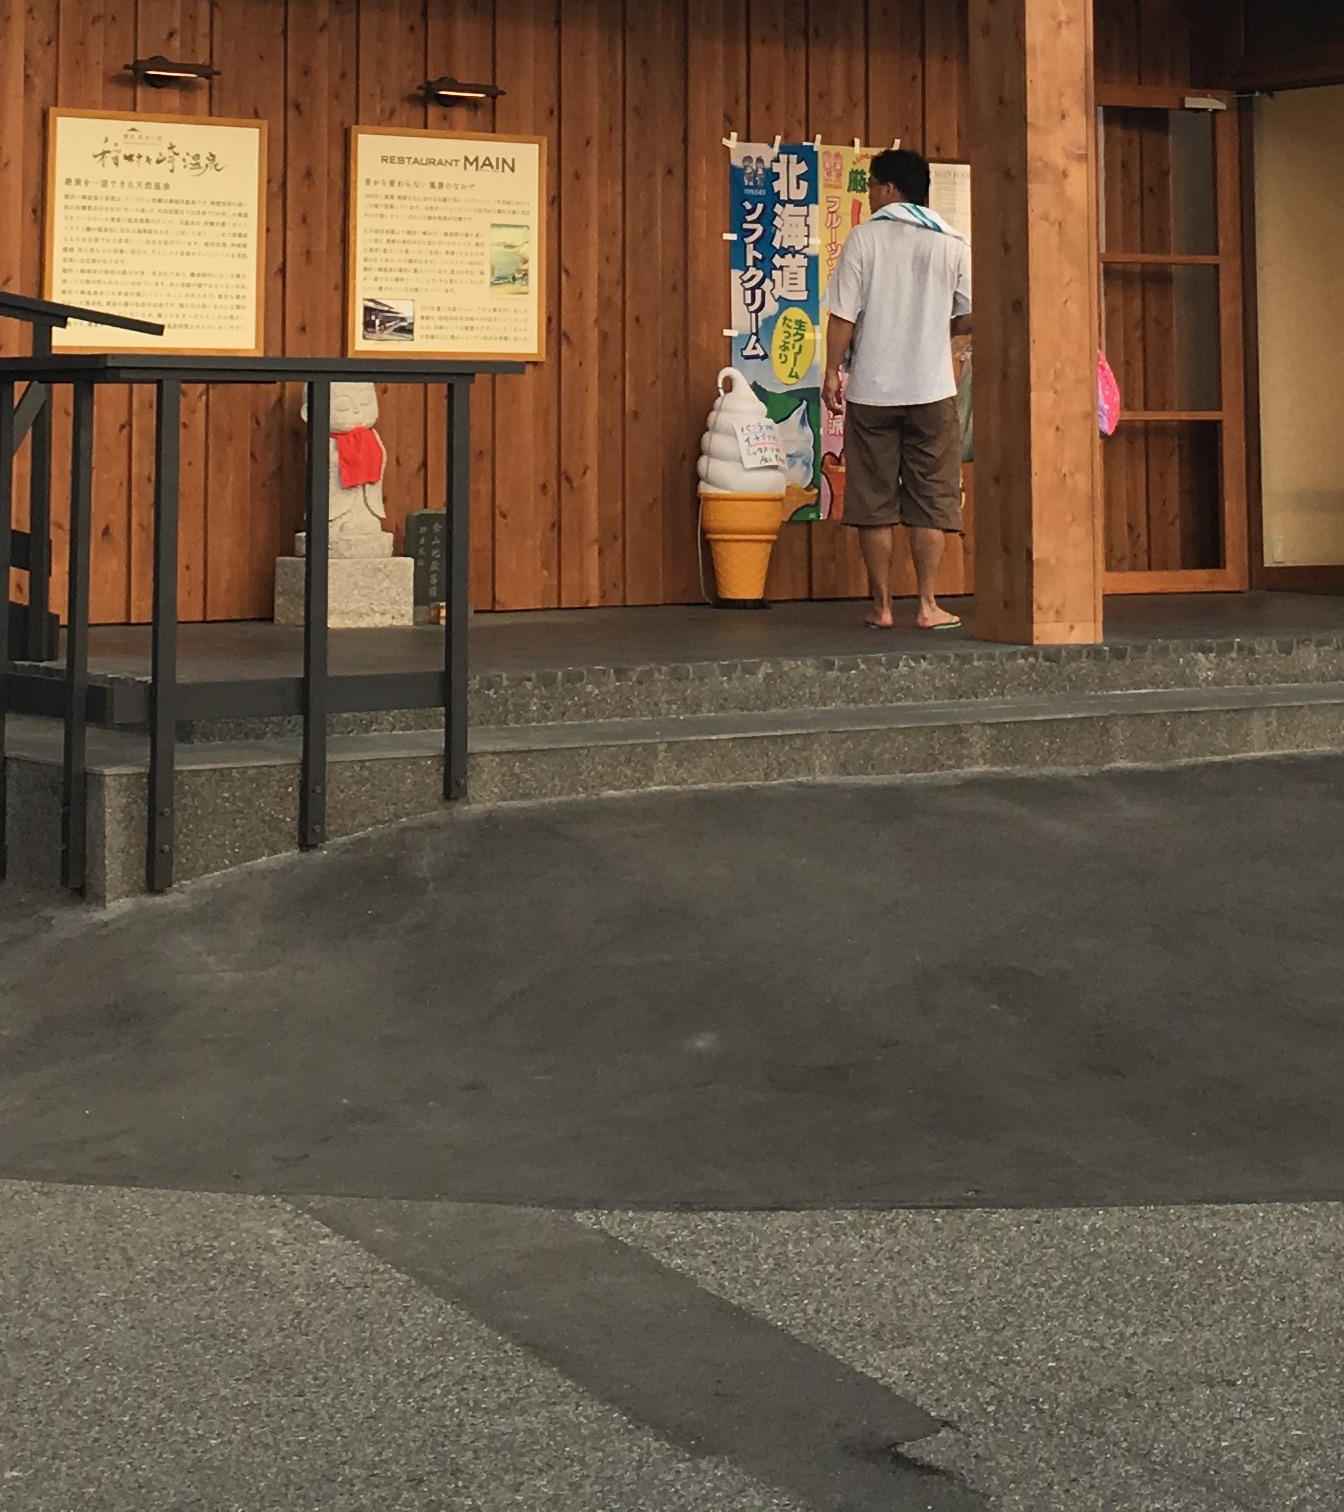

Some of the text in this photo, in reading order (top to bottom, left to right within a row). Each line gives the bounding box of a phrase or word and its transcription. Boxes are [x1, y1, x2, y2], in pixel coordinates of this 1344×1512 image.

[380, 155, 516, 174] RESTAURANT MAIN
[771, 152, 809, 302] 北海道
[740, 200, 768, 361] ソフトクリーム
[778, 315, 793, 364] たっぷり
[788, 319, 807, 380] 生クリーム
